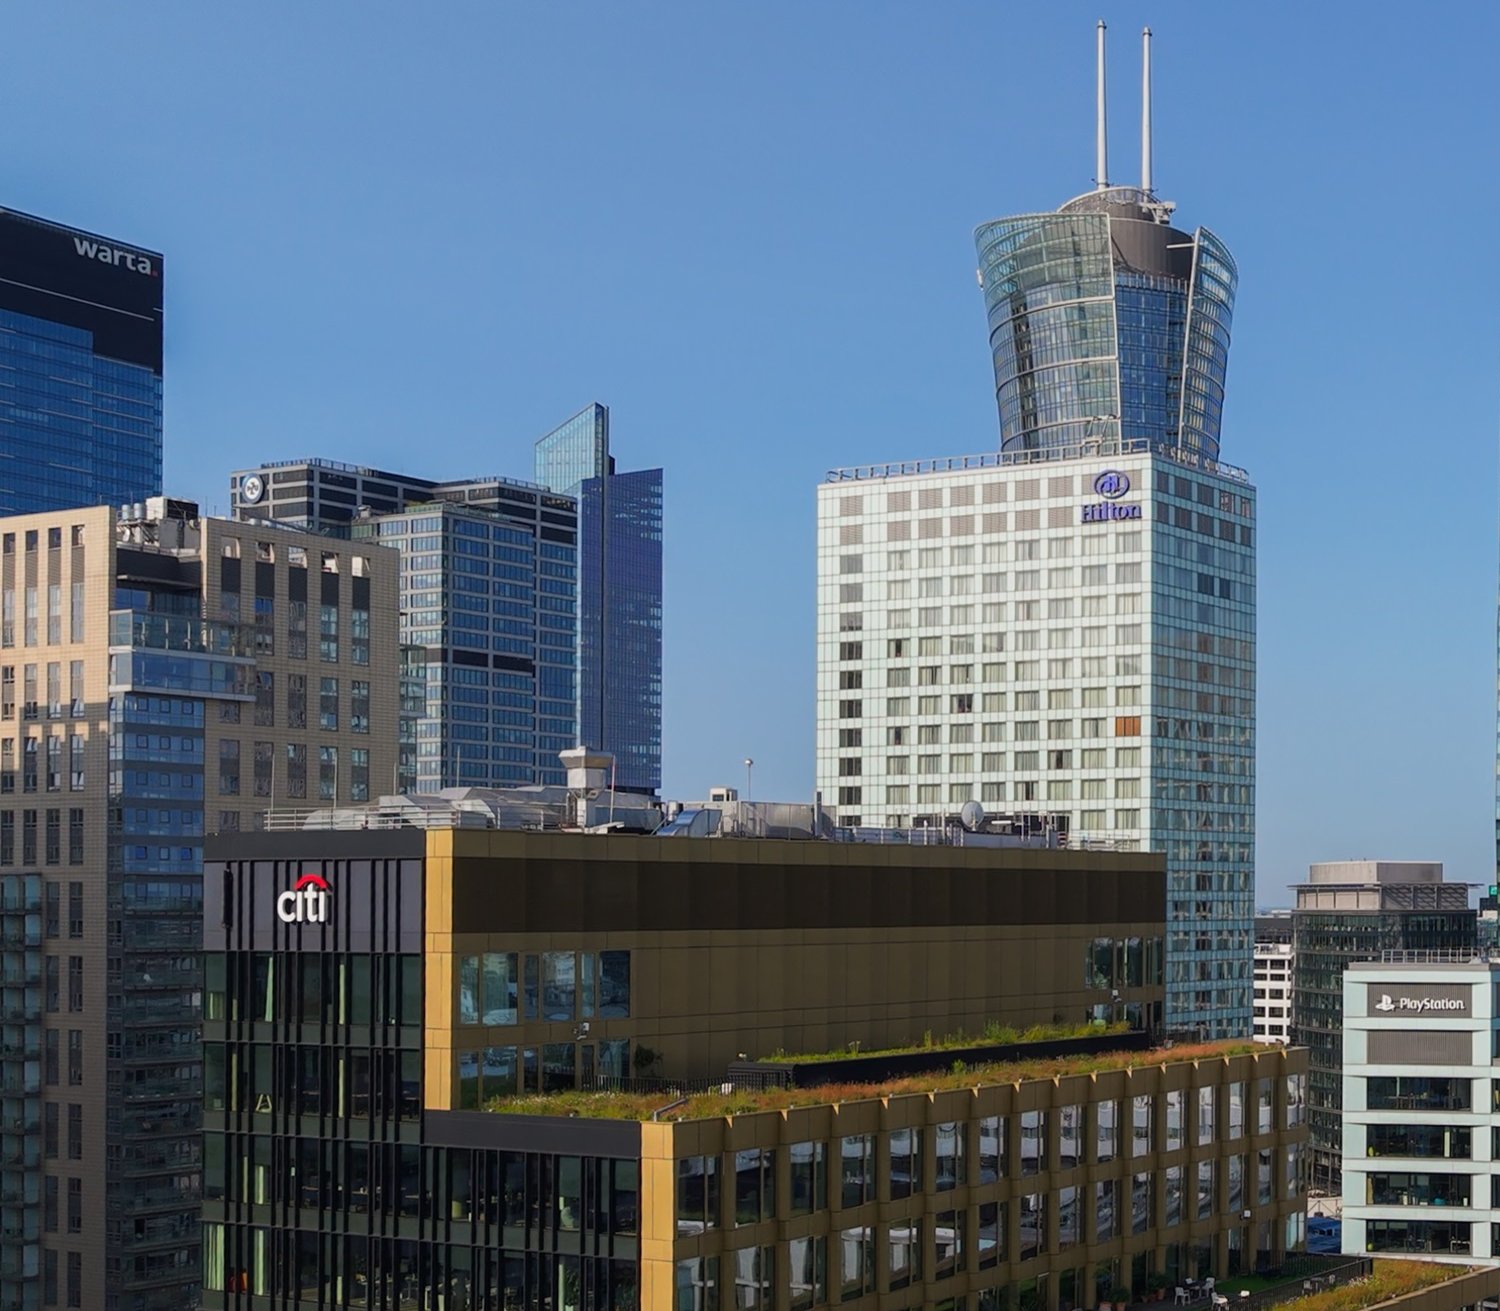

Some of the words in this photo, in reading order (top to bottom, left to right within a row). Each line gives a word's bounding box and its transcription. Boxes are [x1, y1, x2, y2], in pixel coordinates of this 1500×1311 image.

[1081, 501, 1142, 524] Hilton
[277, 882, 325, 923] citi
[1400, 997, 1465, 1013] PlayStation
